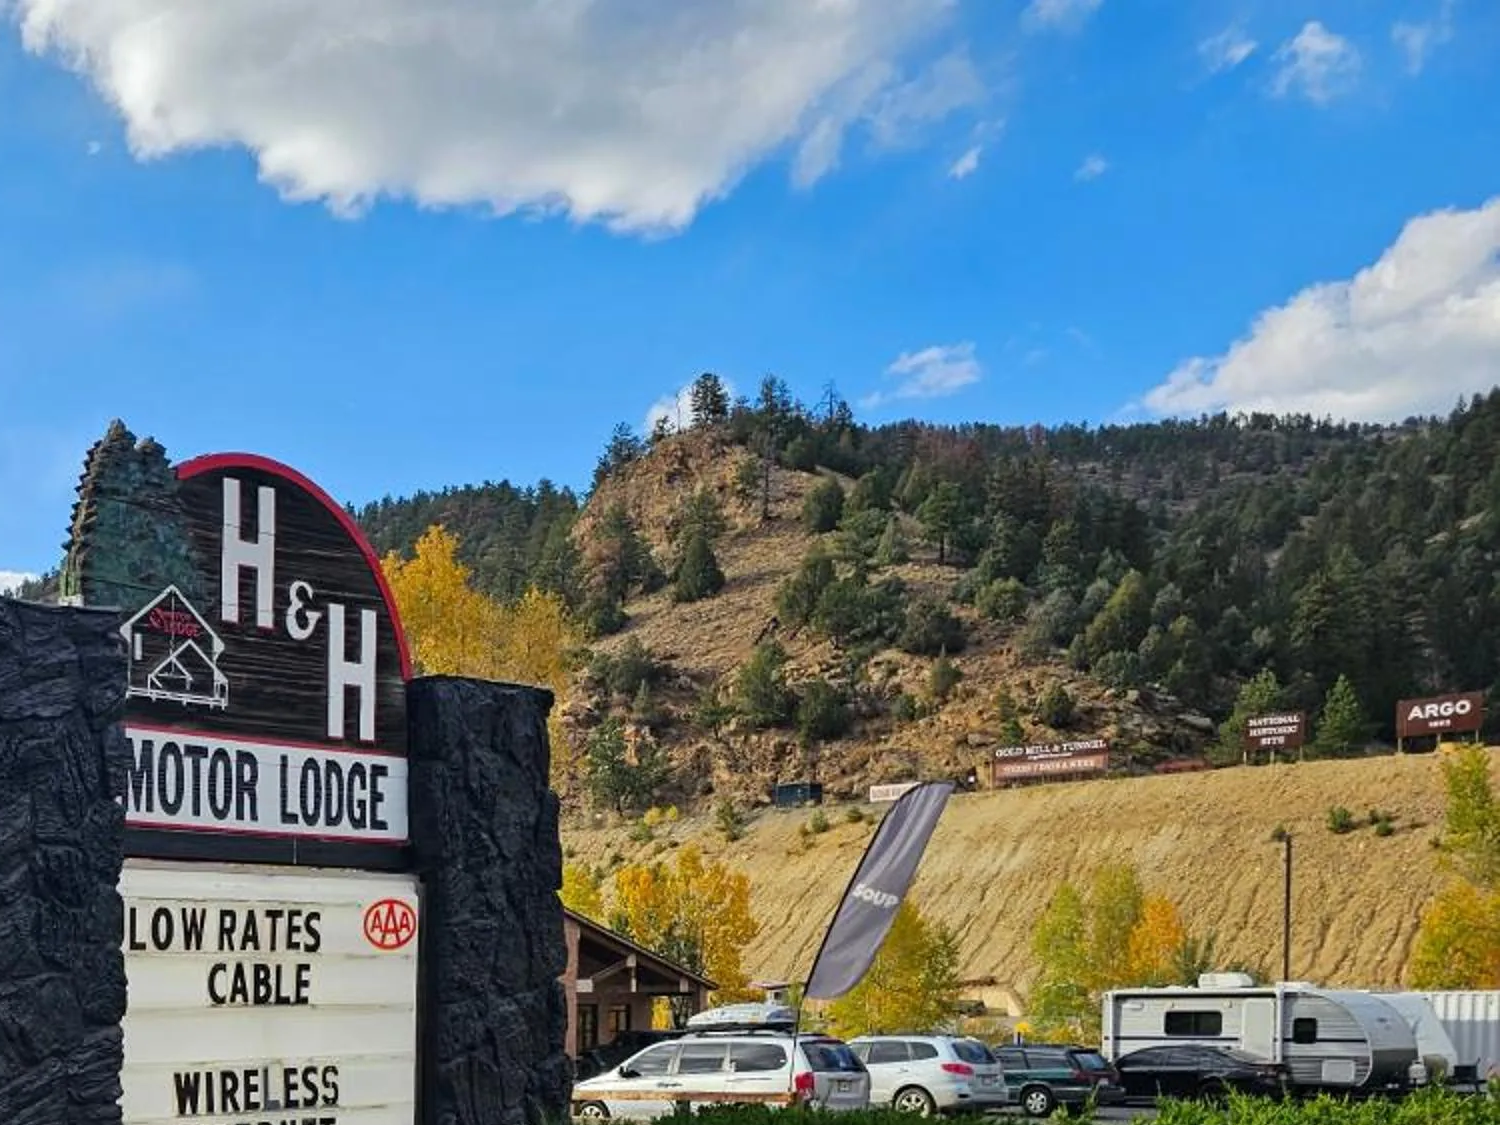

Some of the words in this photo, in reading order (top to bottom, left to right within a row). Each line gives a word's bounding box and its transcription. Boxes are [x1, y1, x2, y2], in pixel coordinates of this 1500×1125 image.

[1407, 699, 1472, 721] ARGO
[125, 736, 259, 822] MOTOR
[280, 754, 389, 831] LODGE
[852, 882, 900, 909] SOUP
[129, 906, 207, 951] LOW
[218, 909, 322, 953] RATES
[370, 901, 411, 945] AAA
[207, 962, 311, 1005] CABLE
[173, 1065, 340, 1116] WIRELESS
